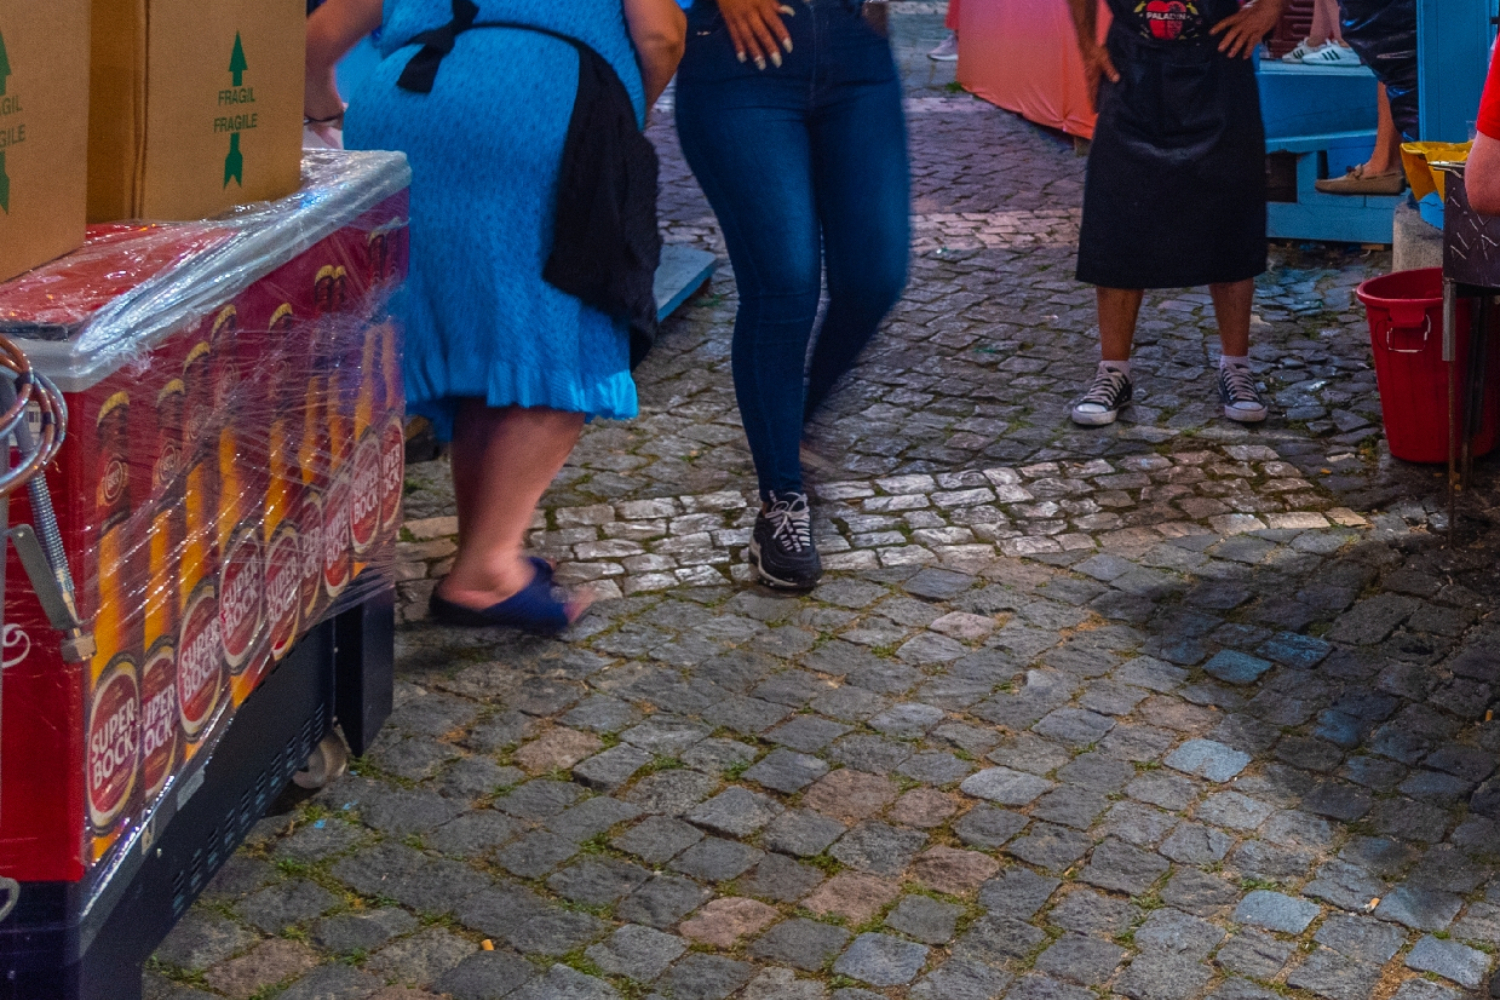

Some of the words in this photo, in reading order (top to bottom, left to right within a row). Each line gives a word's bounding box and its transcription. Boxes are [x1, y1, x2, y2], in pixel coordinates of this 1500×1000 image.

[0, 95, 24, 116] GIL
[218, 87, 256, 106] FRAGIL
[0, 123, 26, 148] GILE
[213, 113, 258, 133] FRAGILE
[182, 615, 221, 678] SUPER
[184, 648, 219, 702] BOCK
[92, 697, 135, 764] SUPER
[144, 712, 173, 756] OCK
[94, 725, 136, 790] BOCK
